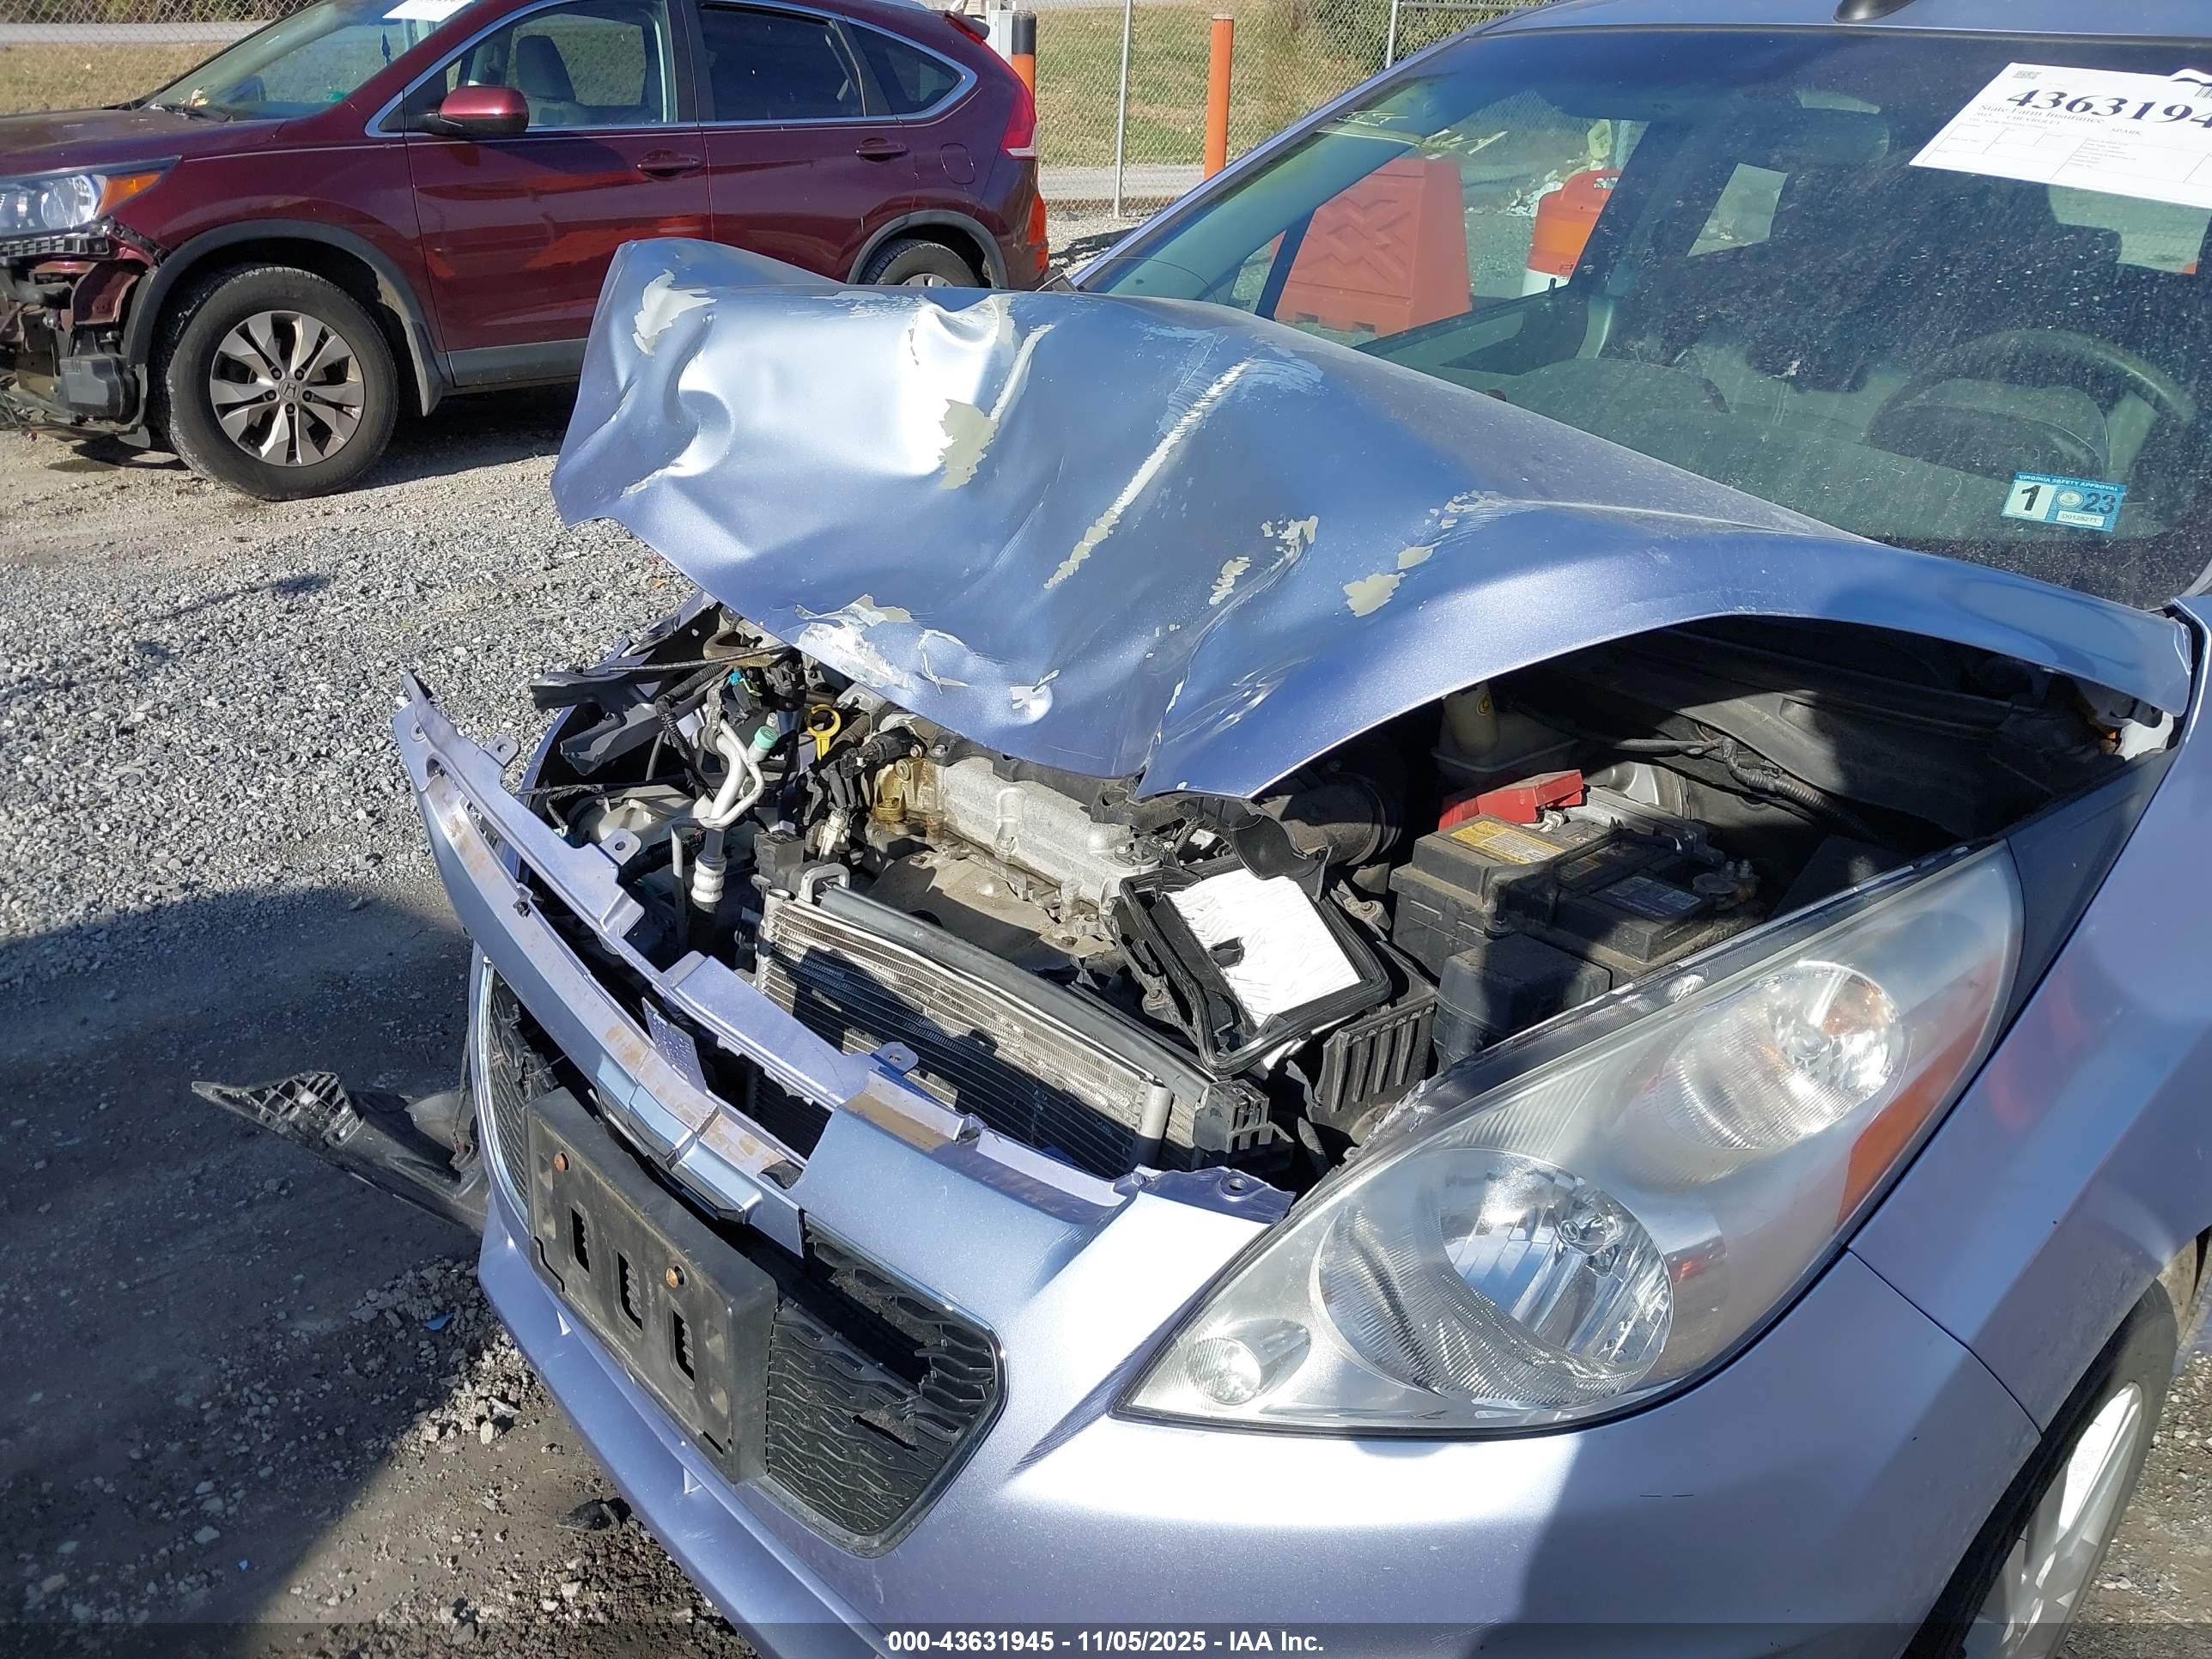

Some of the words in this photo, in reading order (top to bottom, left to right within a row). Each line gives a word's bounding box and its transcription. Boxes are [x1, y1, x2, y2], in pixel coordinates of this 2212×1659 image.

[1978, 104, 2008, 113] State
[2011, 107, 2044, 117] Farm
[2045, 111, 2106, 124] Insurance
[2018, 474, 2051, 483] VIRGINIA
[2079, 481, 2118, 491] APPROVAL
[2021, 484, 2041, 511] 1
[2081, 492, 2116, 514] 23
